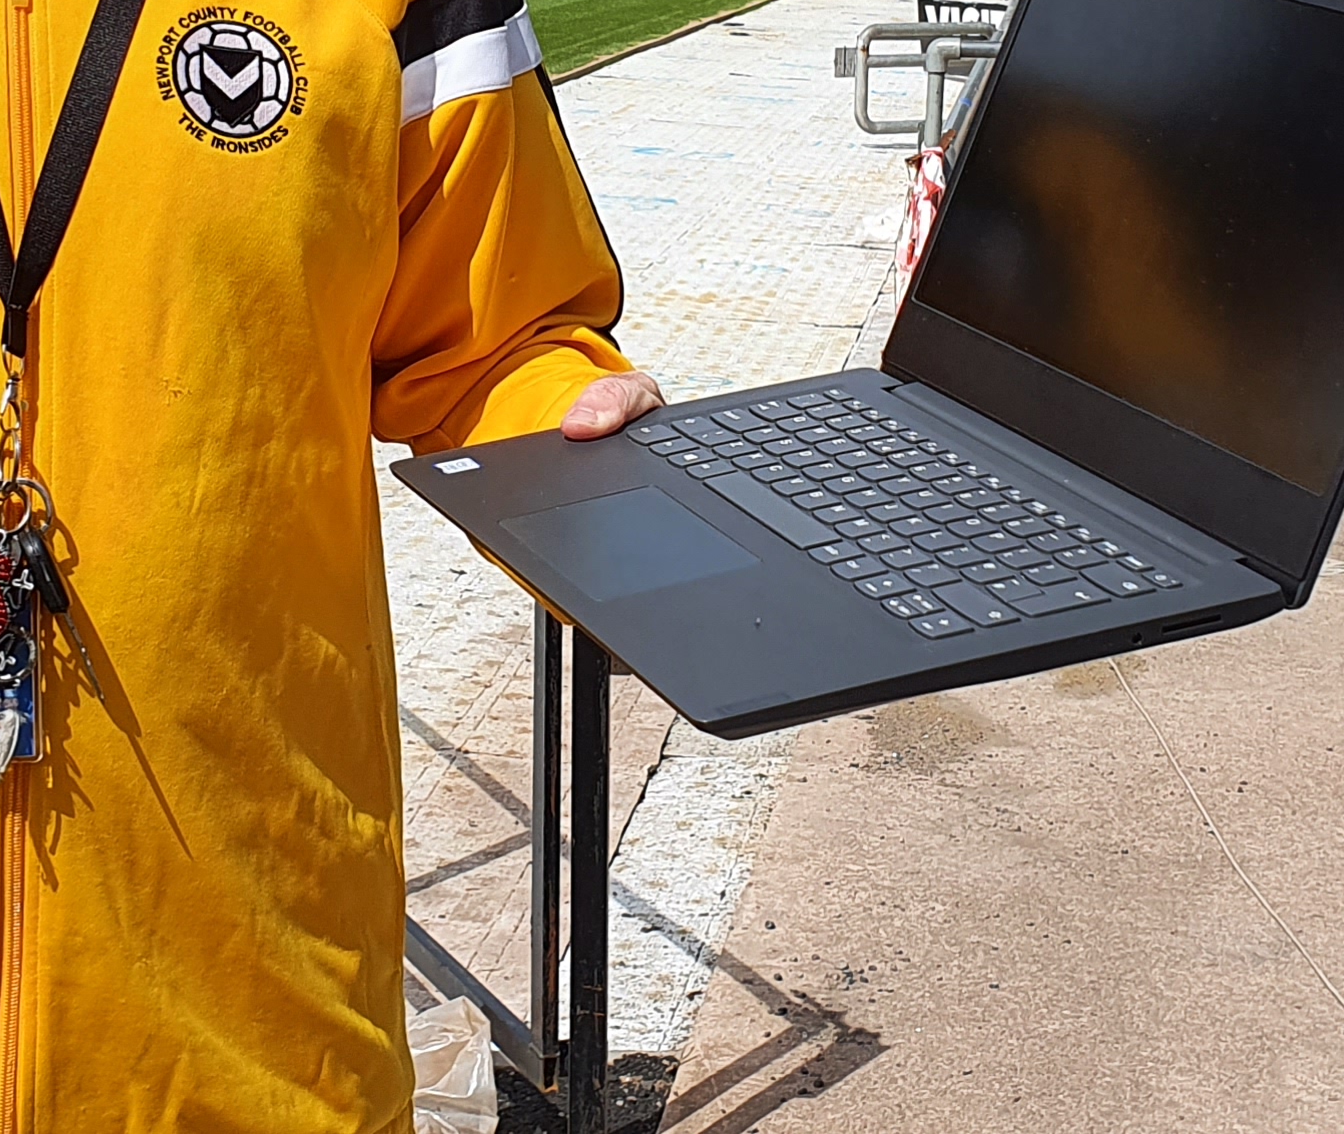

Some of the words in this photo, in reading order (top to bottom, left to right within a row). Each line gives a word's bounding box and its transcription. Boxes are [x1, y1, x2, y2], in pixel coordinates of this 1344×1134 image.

[155, 25, 182, 101] NEWPORT
[178, 6, 238, 29] COUNTY
[242, 10, 306, 73] FOOTBALL
[289, 76, 309, 116] CLUB
[178, 112, 208, 142] THE
[210, 125, 289, 154] IRONSIDES
